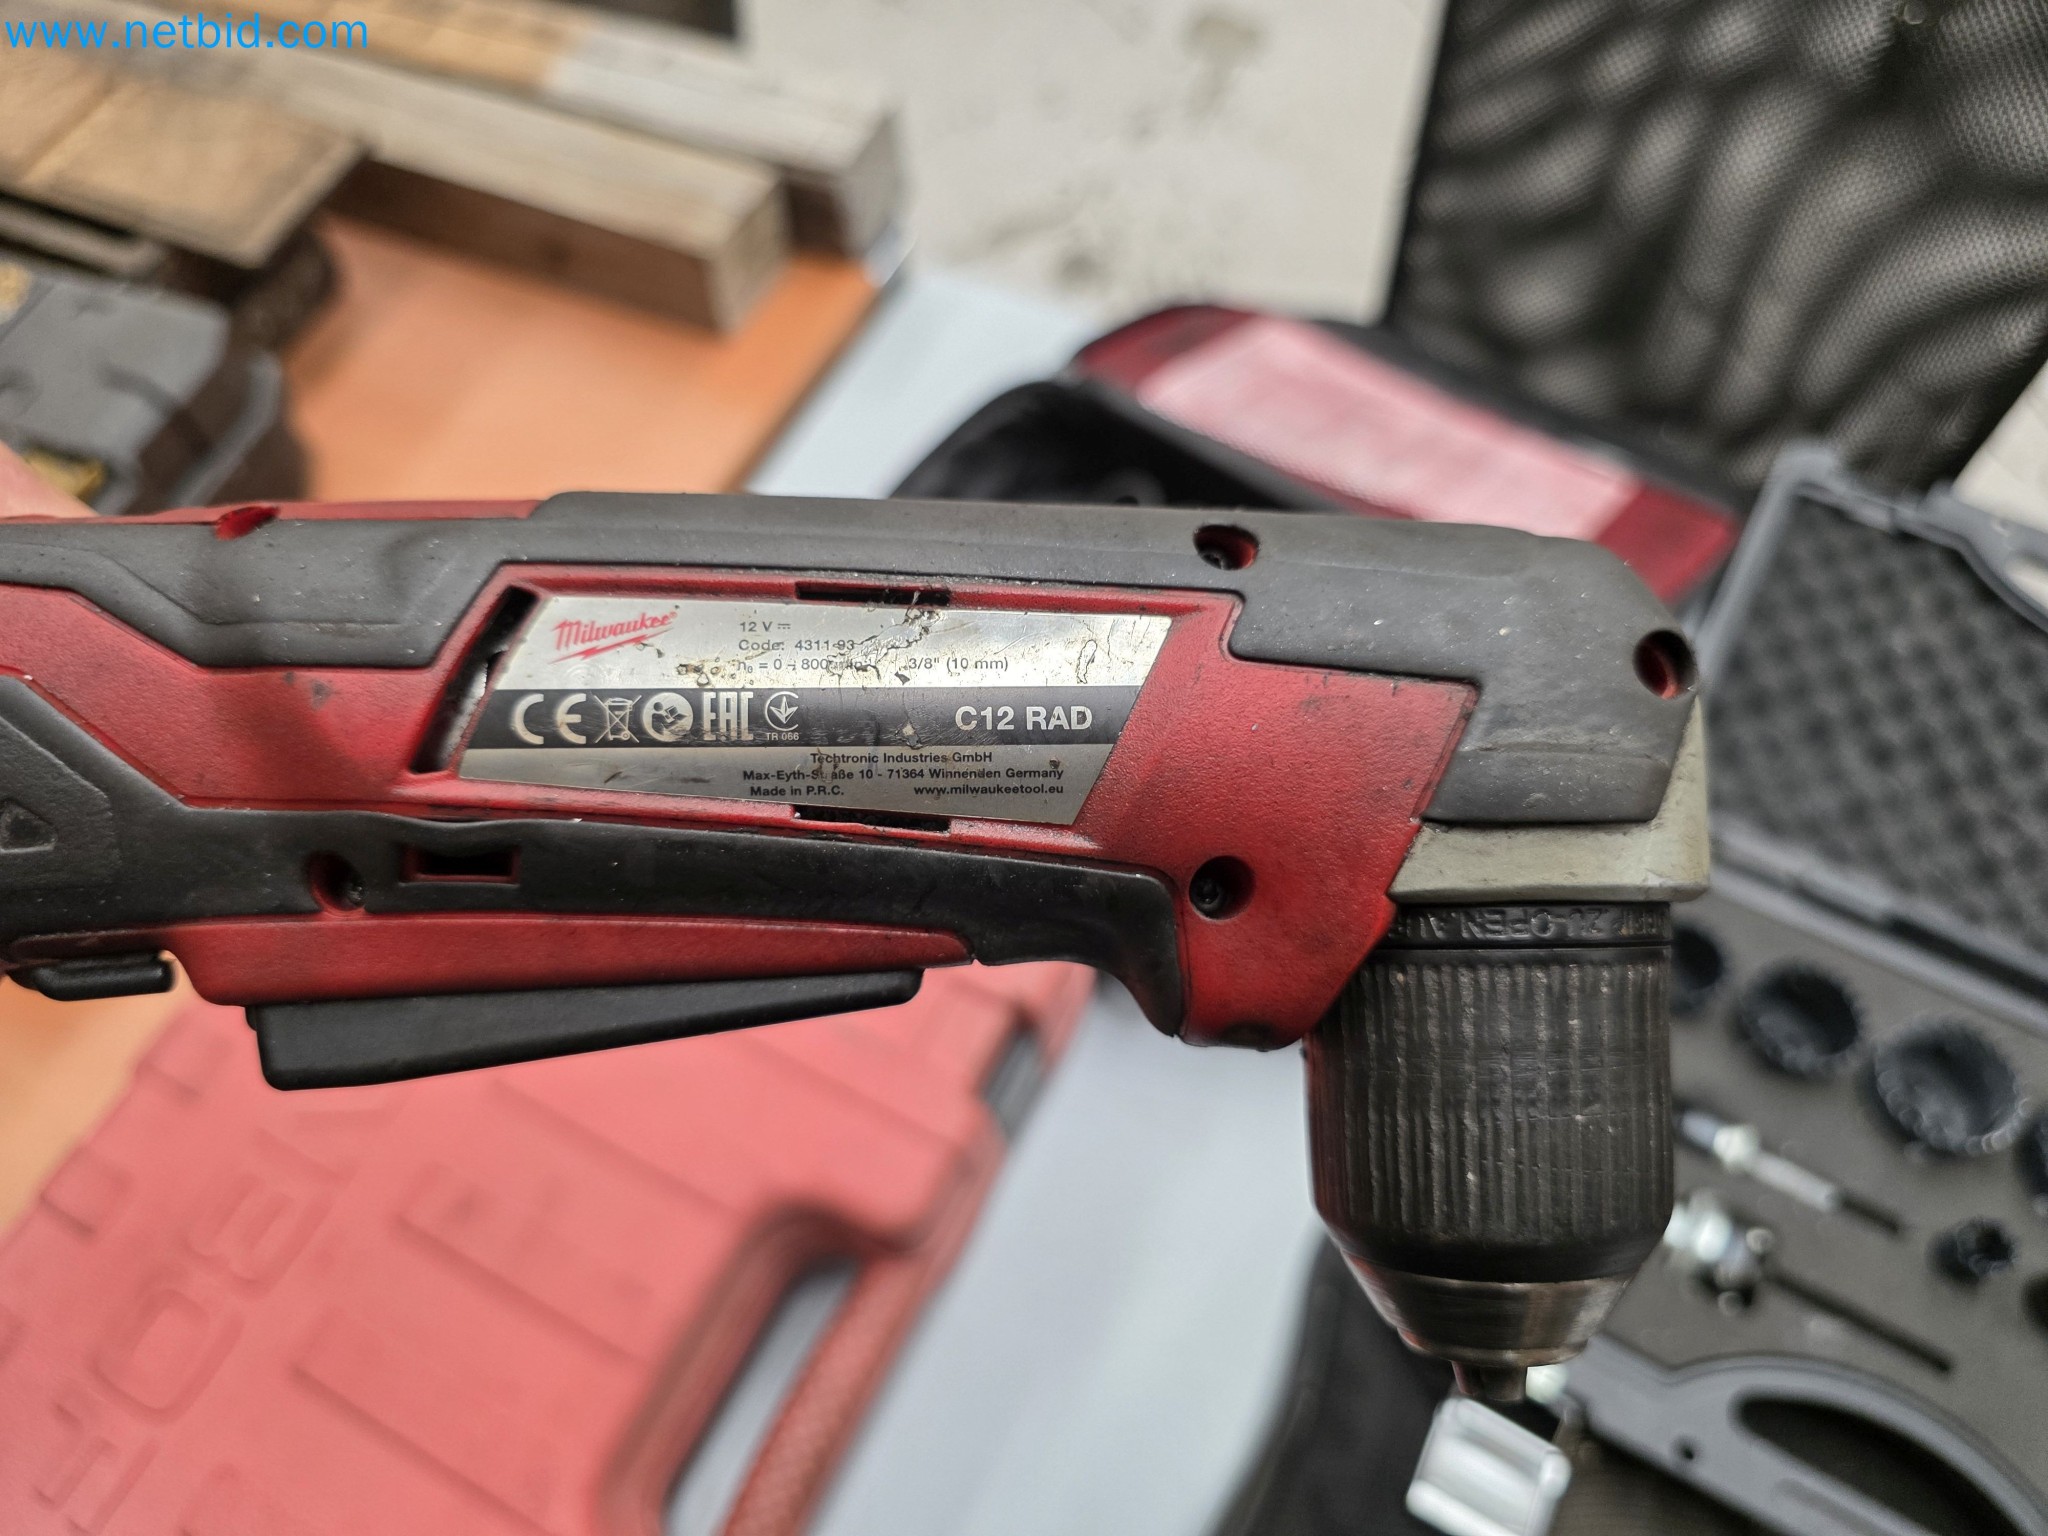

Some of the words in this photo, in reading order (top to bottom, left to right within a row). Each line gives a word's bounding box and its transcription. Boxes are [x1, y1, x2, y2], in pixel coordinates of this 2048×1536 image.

[552, 613, 672, 650] Milwaukee
[740, 622, 760, 632] 12
[763, 622, 773, 632] V
[738, 640, 785, 651] Code:
[773, 658, 783, 670] 0
[908, 657, 940, 671] 3/8"
[946, 656, 969, 672] (10
[974, 656, 1009, 672] mm)
[511, 692, 587, 745] CE
[954, 705, 1015, 731] C12
[1025, 706, 1093, 731] RAD
[766, 732, 780, 741] TR
[781, 732, 800, 741] 066
[810, 752, 879, 764] Techtronic
[883, 752, 948, 763] Industries
[952, 751, 993, 763] GmbH
[859, 769, 873, 779] 10
[887, 768, 925, 779] 71364
[929, 768, 1001, 779] Winnenden
[1005, 767, 1064, 780] Germany
[750, 785, 786, 796] Made
[791, 785, 802, 796] in
[806, 785, 845, 796] P.R.C.
[914, 783, 1064, 795] www.milwaukeetool.eu
